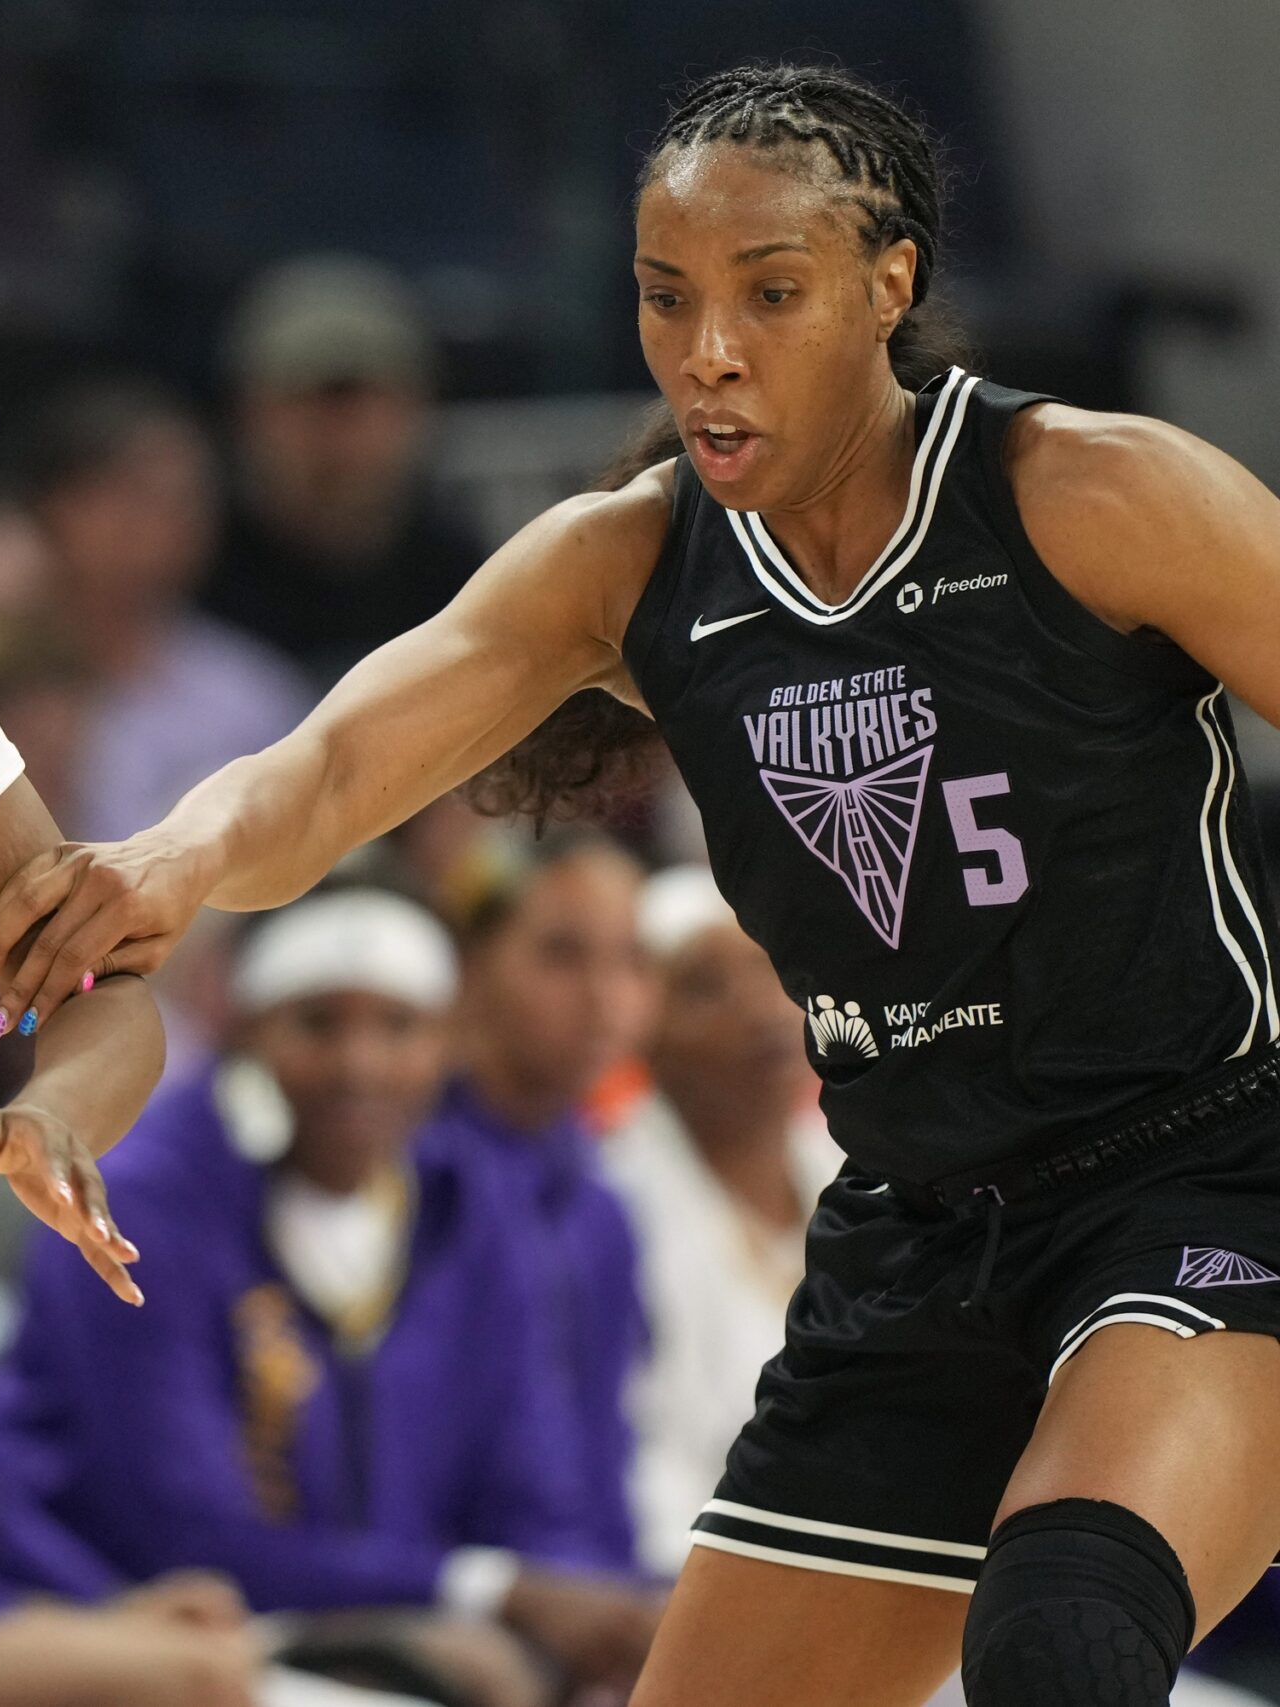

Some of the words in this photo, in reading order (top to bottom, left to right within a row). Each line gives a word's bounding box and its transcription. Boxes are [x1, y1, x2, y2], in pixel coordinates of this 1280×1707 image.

[931, 573, 1008, 605] freedom
[769, 679, 844, 708] GOLDEN
[849, 665, 906, 697] STATE
[743, 687, 938, 776] VALKYRIES
[940, 772, 1030, 907] 5
